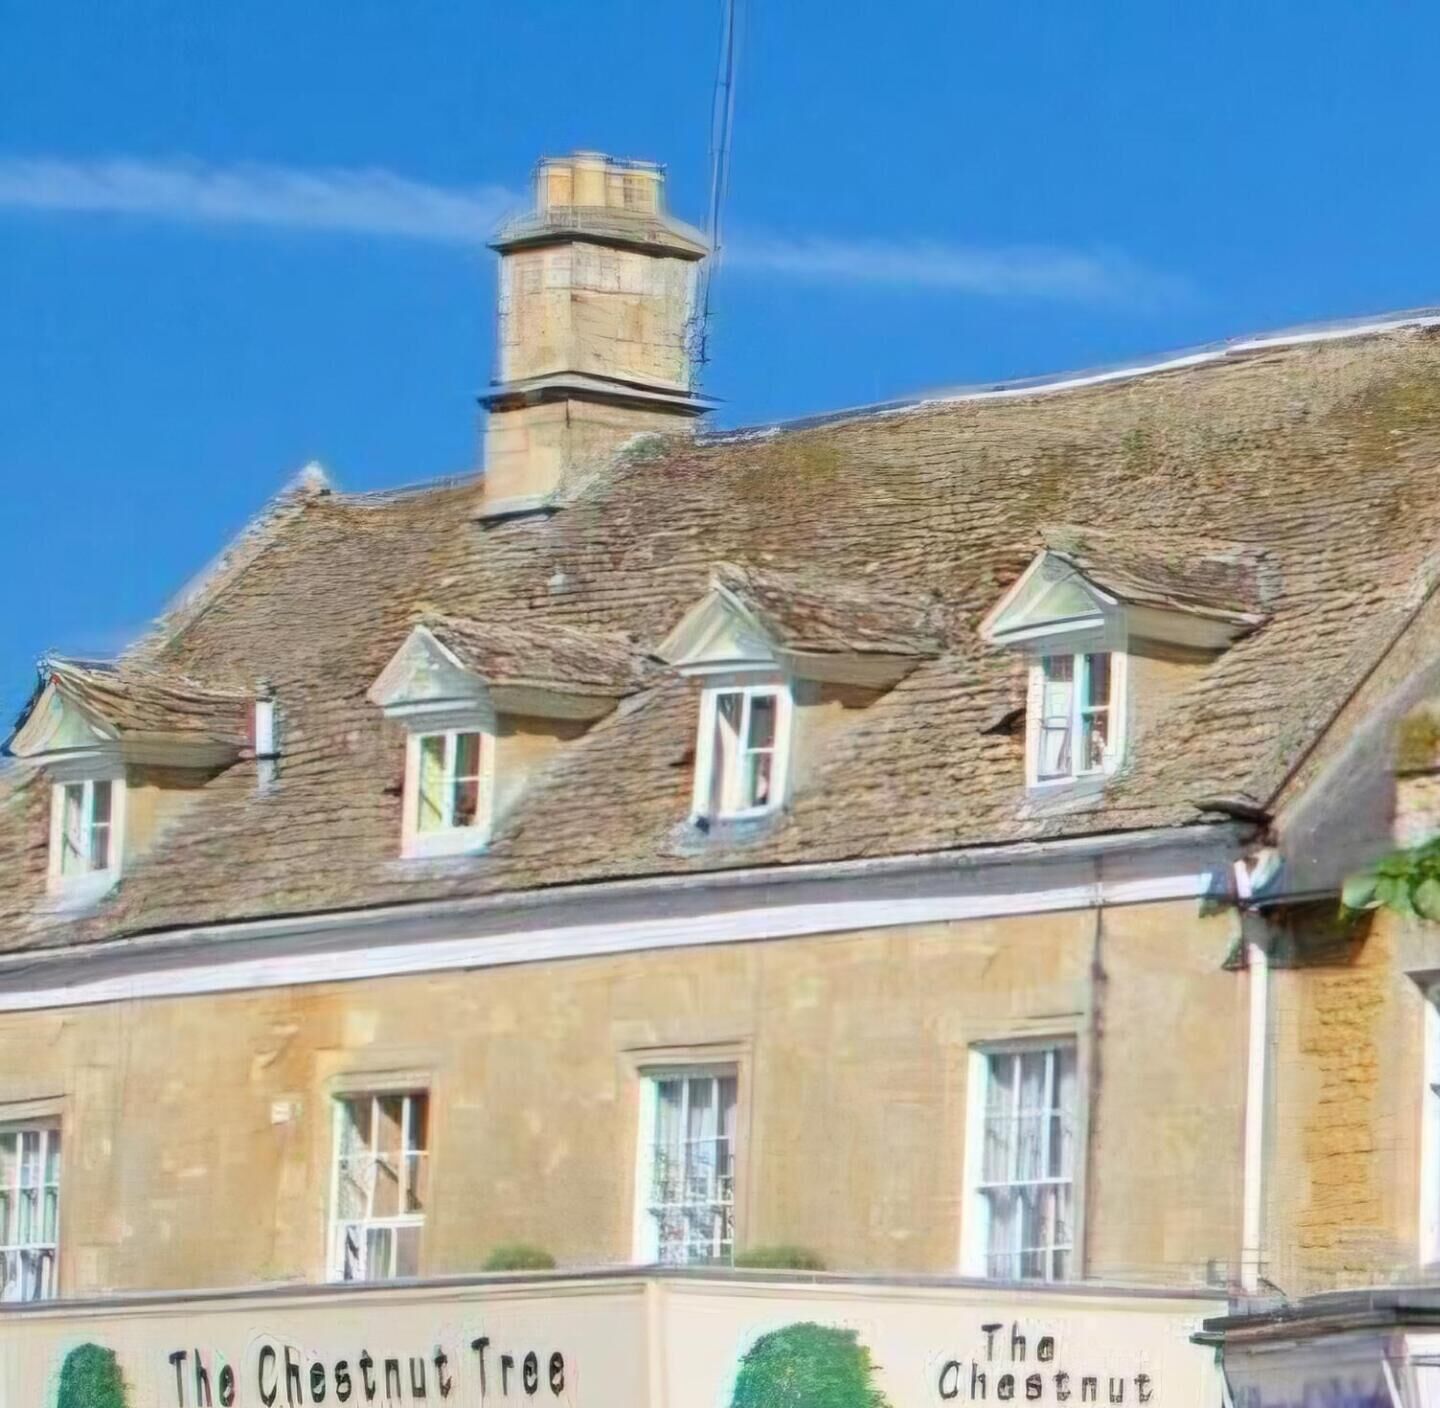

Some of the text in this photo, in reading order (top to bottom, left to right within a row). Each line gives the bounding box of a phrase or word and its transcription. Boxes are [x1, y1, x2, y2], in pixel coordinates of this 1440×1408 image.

[981, 1321, 1055, 1361] The
[169, 1337, 565, 1408] The Chestnut Tree
[938, 1359, 1153, 1404] Chestnut
